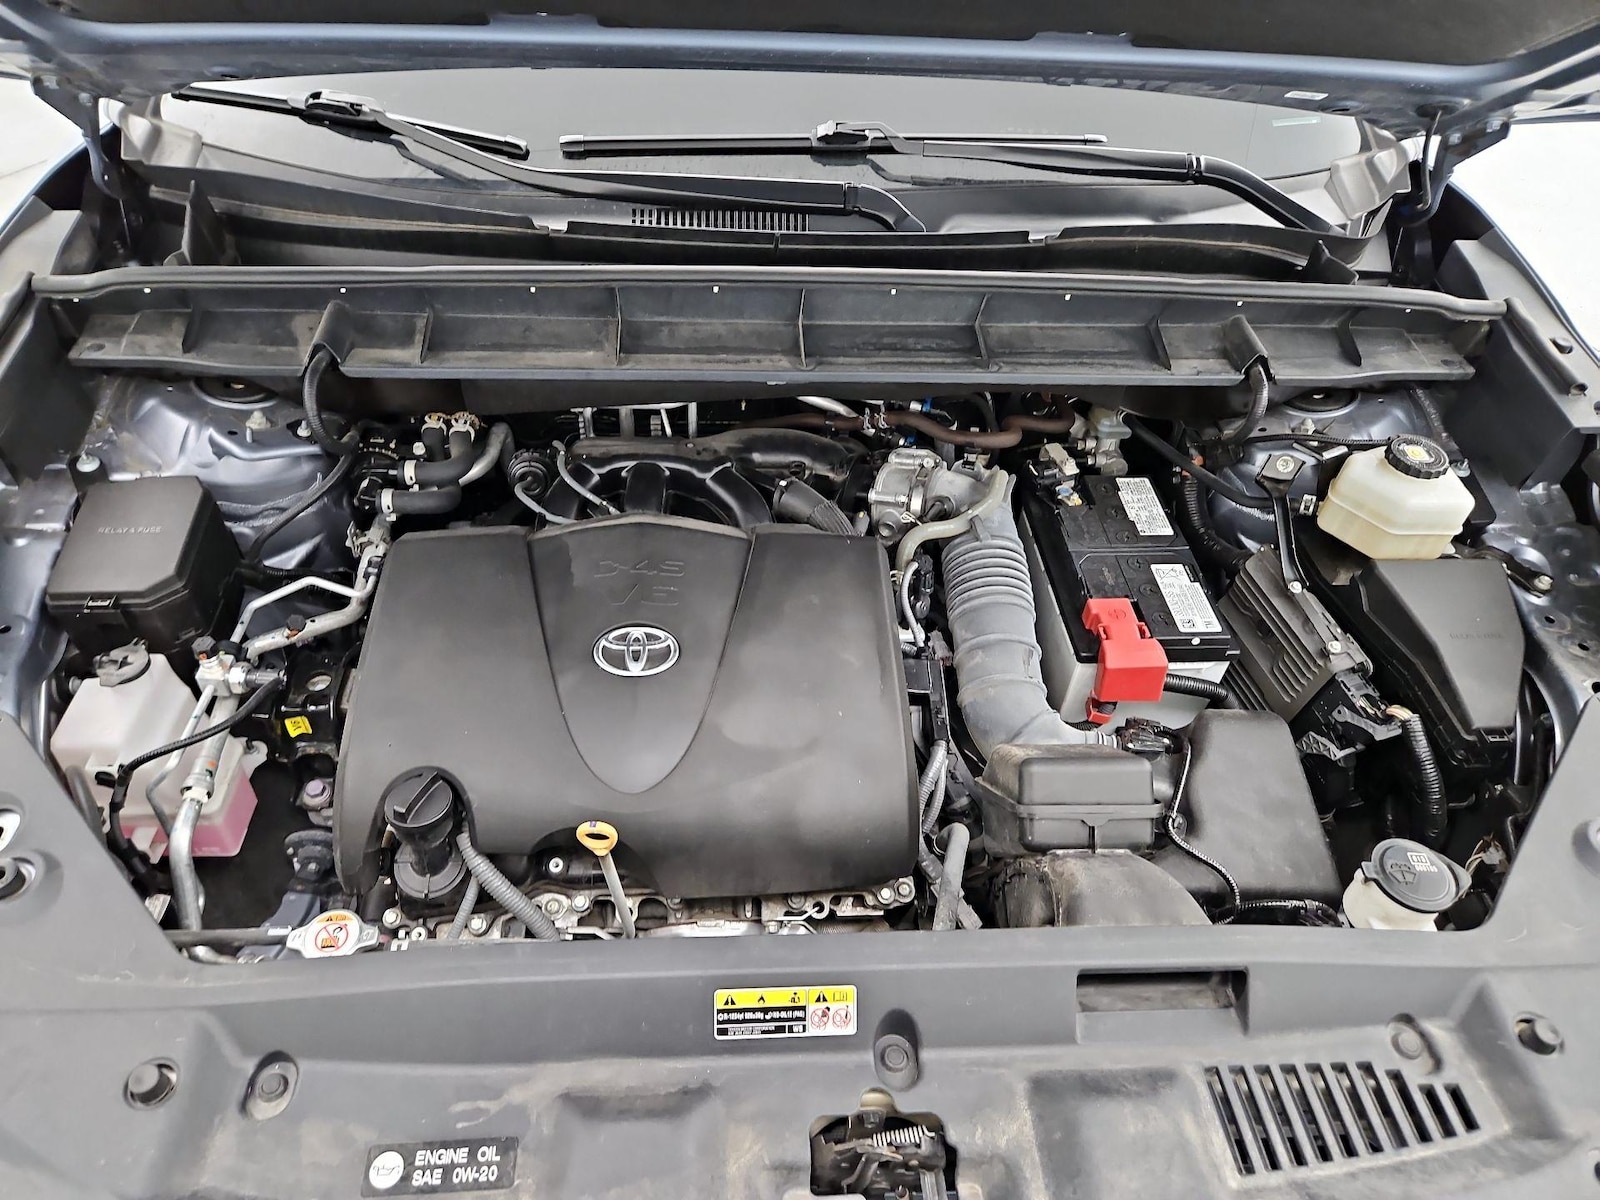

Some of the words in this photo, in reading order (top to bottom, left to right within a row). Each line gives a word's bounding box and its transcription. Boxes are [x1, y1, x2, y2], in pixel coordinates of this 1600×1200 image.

[414, 1147, 469, 1167] ENGINE
[477, 1145, 501, 1163] OIL
[411, 1168, 444, 1187] SAE
[452, 1165, 499, 1184] 0W-20
